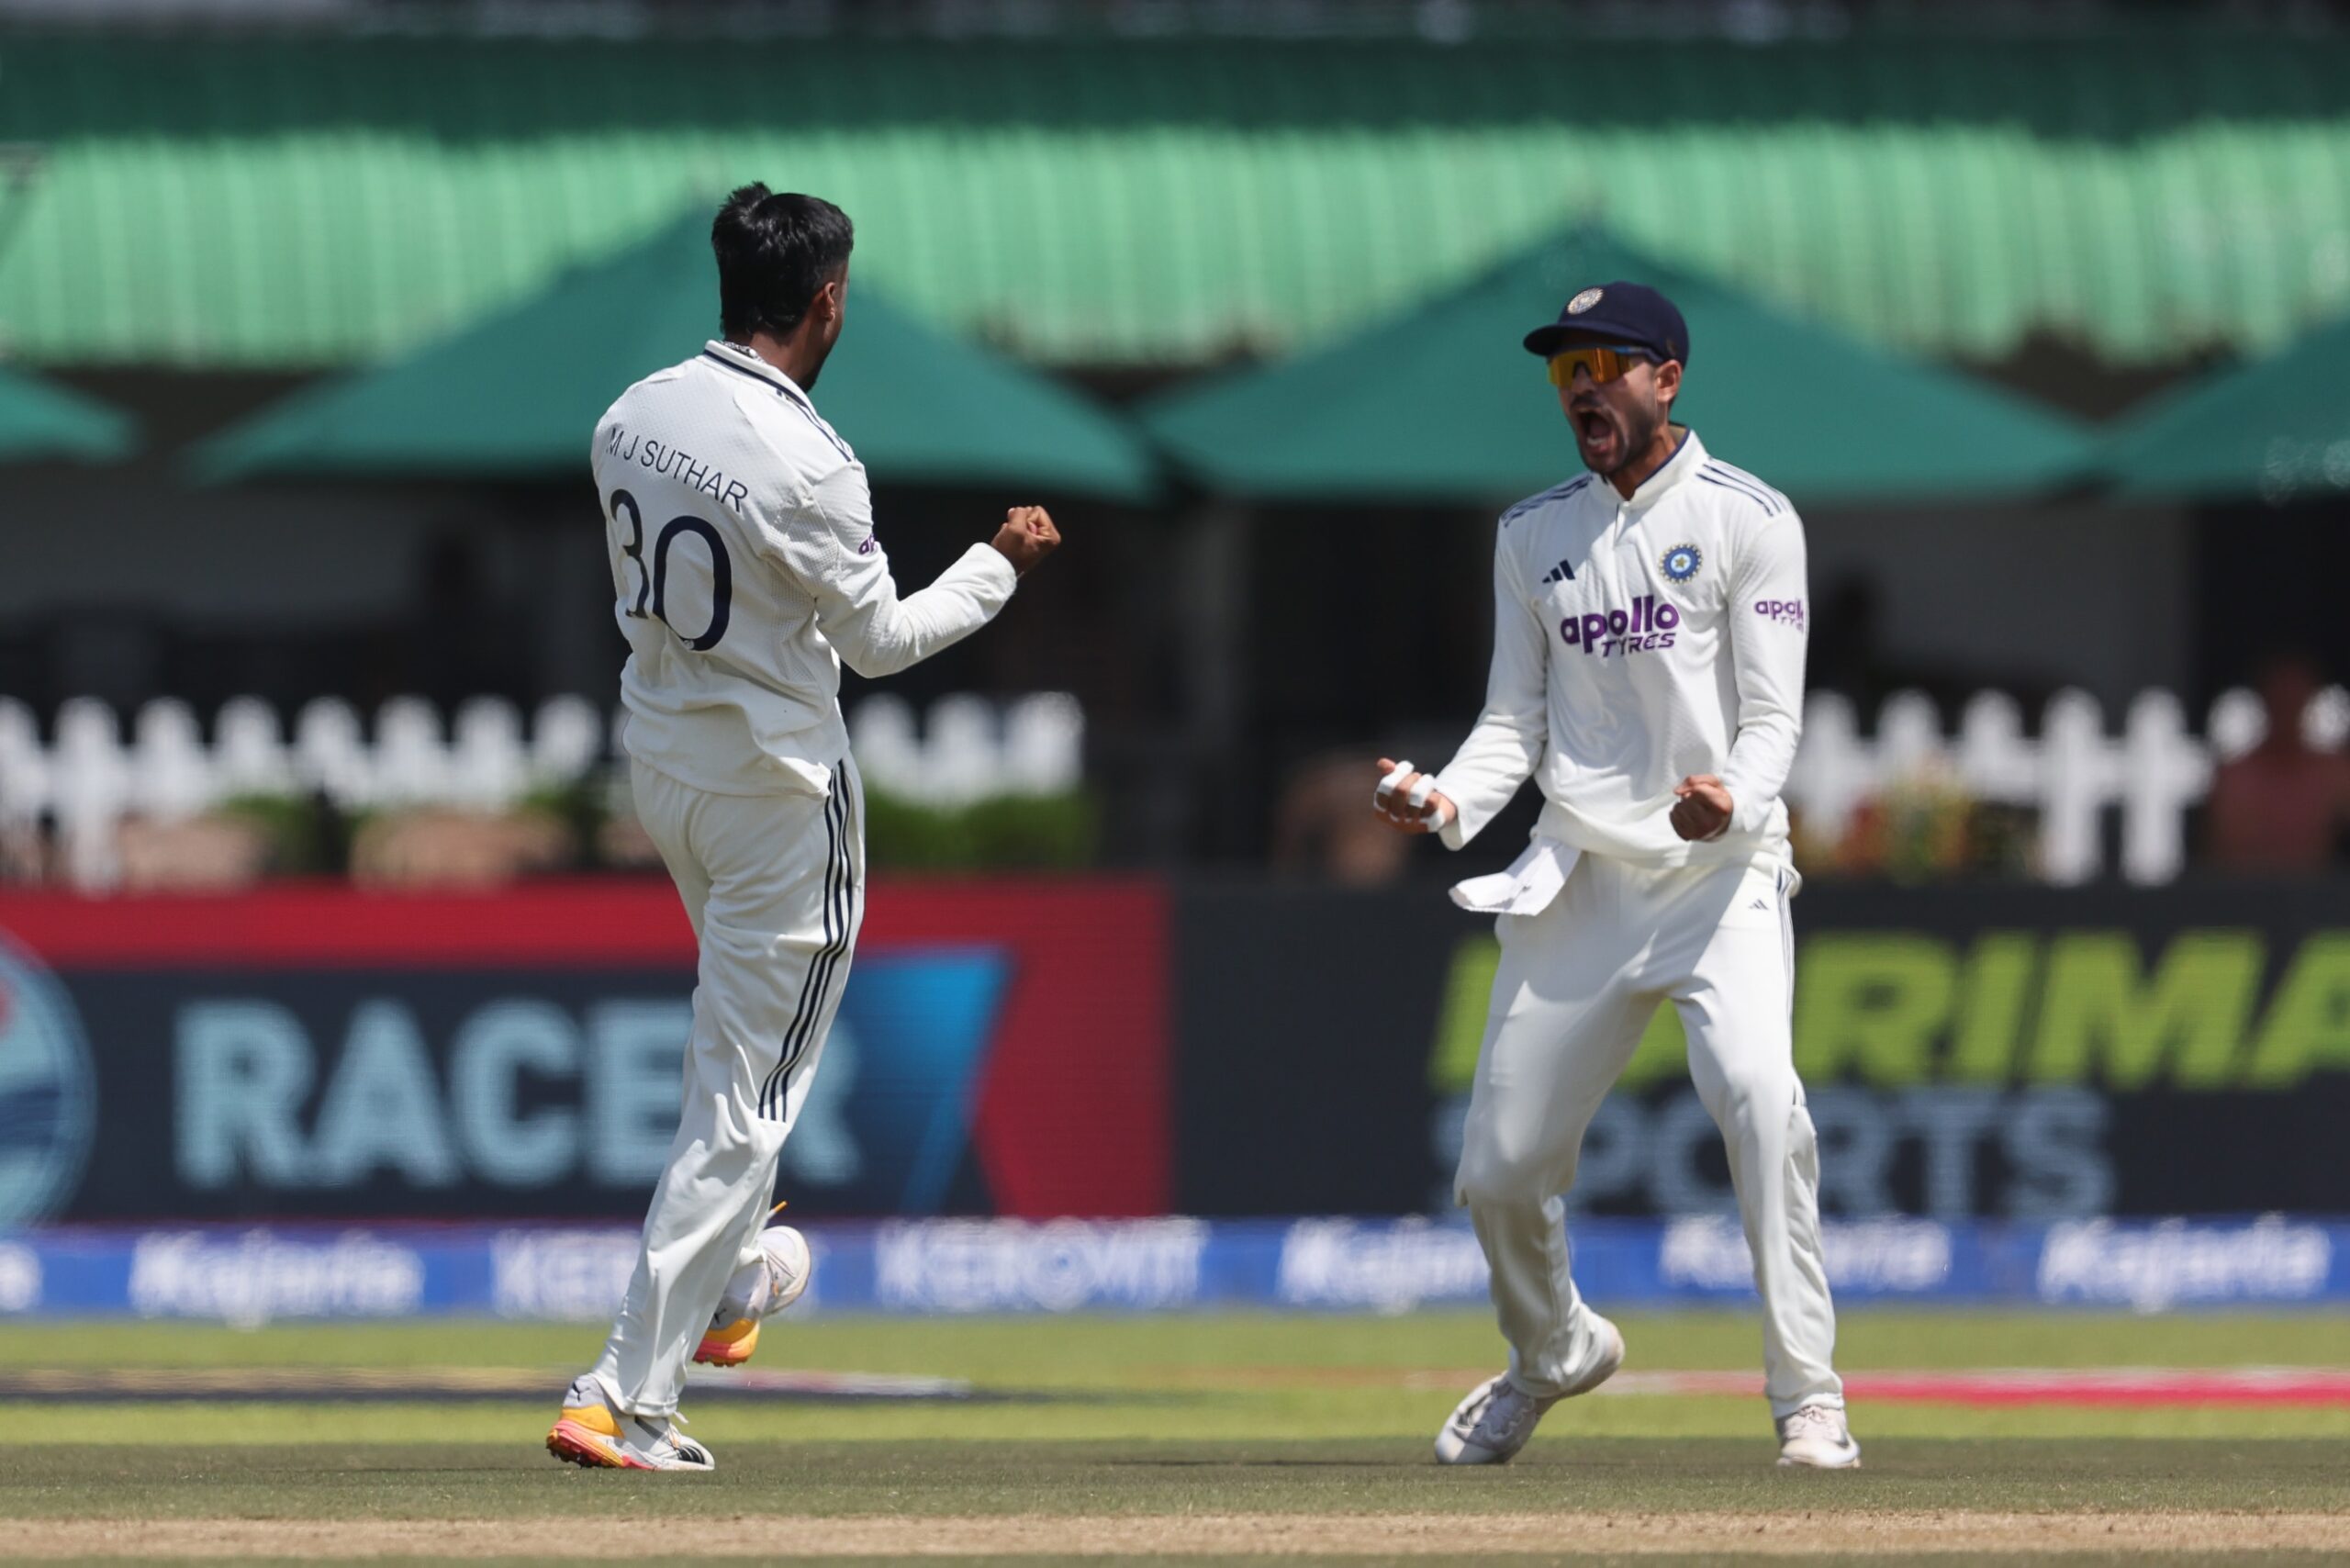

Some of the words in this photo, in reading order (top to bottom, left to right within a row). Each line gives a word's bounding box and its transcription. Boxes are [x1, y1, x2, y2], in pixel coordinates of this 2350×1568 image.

[607, 427, 624, 456] M
[623, 435, 639, 460] J
[640, 440, 748, 513] SUTHAR
[610, 488, 733, 651] 30
[1561, 595, 1680, 655] apollo
[1601, 633, 1676, 657] TYRES
[1754, 599, 1805, 621] apol
[1430, 931, 2350, 1091] RIMA
